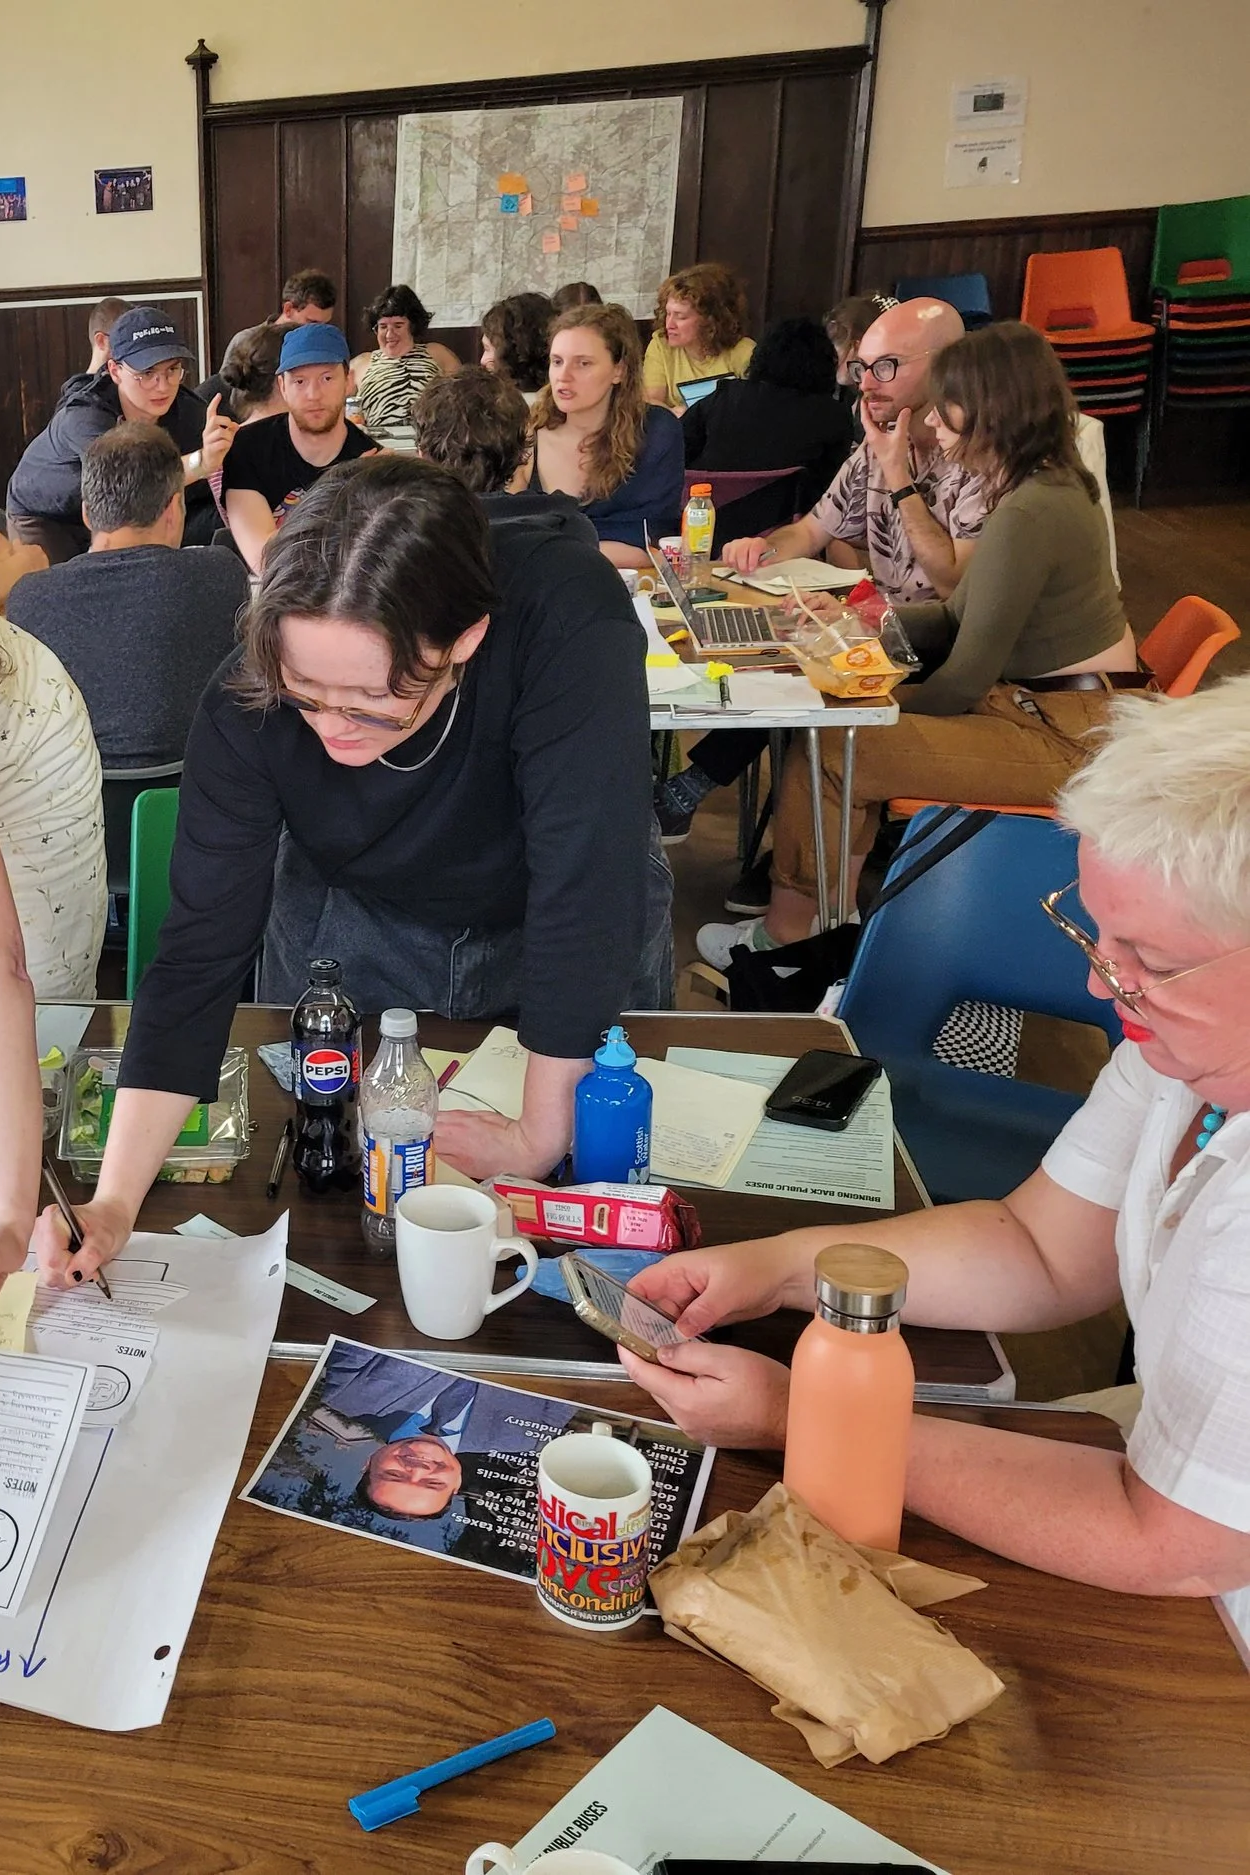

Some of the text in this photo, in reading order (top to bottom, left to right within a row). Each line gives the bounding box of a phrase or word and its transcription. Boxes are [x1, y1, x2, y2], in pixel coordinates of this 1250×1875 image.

[306, 1065, 347, 1076] PEPSI
[792, 1096, 831, 1108] 14:36
[635, 1126, 644, 1165] Scottish
[641, 1133, 649, 1163] Water
[744, 1181, 881, 1203] BRINGING BACK PUBLIC BUSES
[115, 1345, 146, 1358] NOTES:
[504, 1416, 688, 1466] Chair, Industry
[524, 1429, 552, 1443] Vice
[487, 1449, 528, 1468] fixing
[651, 1441, 690, 1458] Trust
[2, 1476, 38, 1493] NOTES:
[476, 1468, 534, 1487] councils
[485, 1490, 525, 1508] We're
[658, 1501, 674, 1512] to
[475, 1498, 537, 1521] here the
[451, 1512, 493, 1534] taxes,
[496, 1514, 508, 1525] is
[498, 1537, 518, 1548] of
[541, 1519, 648, 1567] nclusiv
[537, 1537, 620, 1599] ove
[580, 1610, 625, 1621] NATIONAL
[572, 1799, 609, 1832] BUSES
